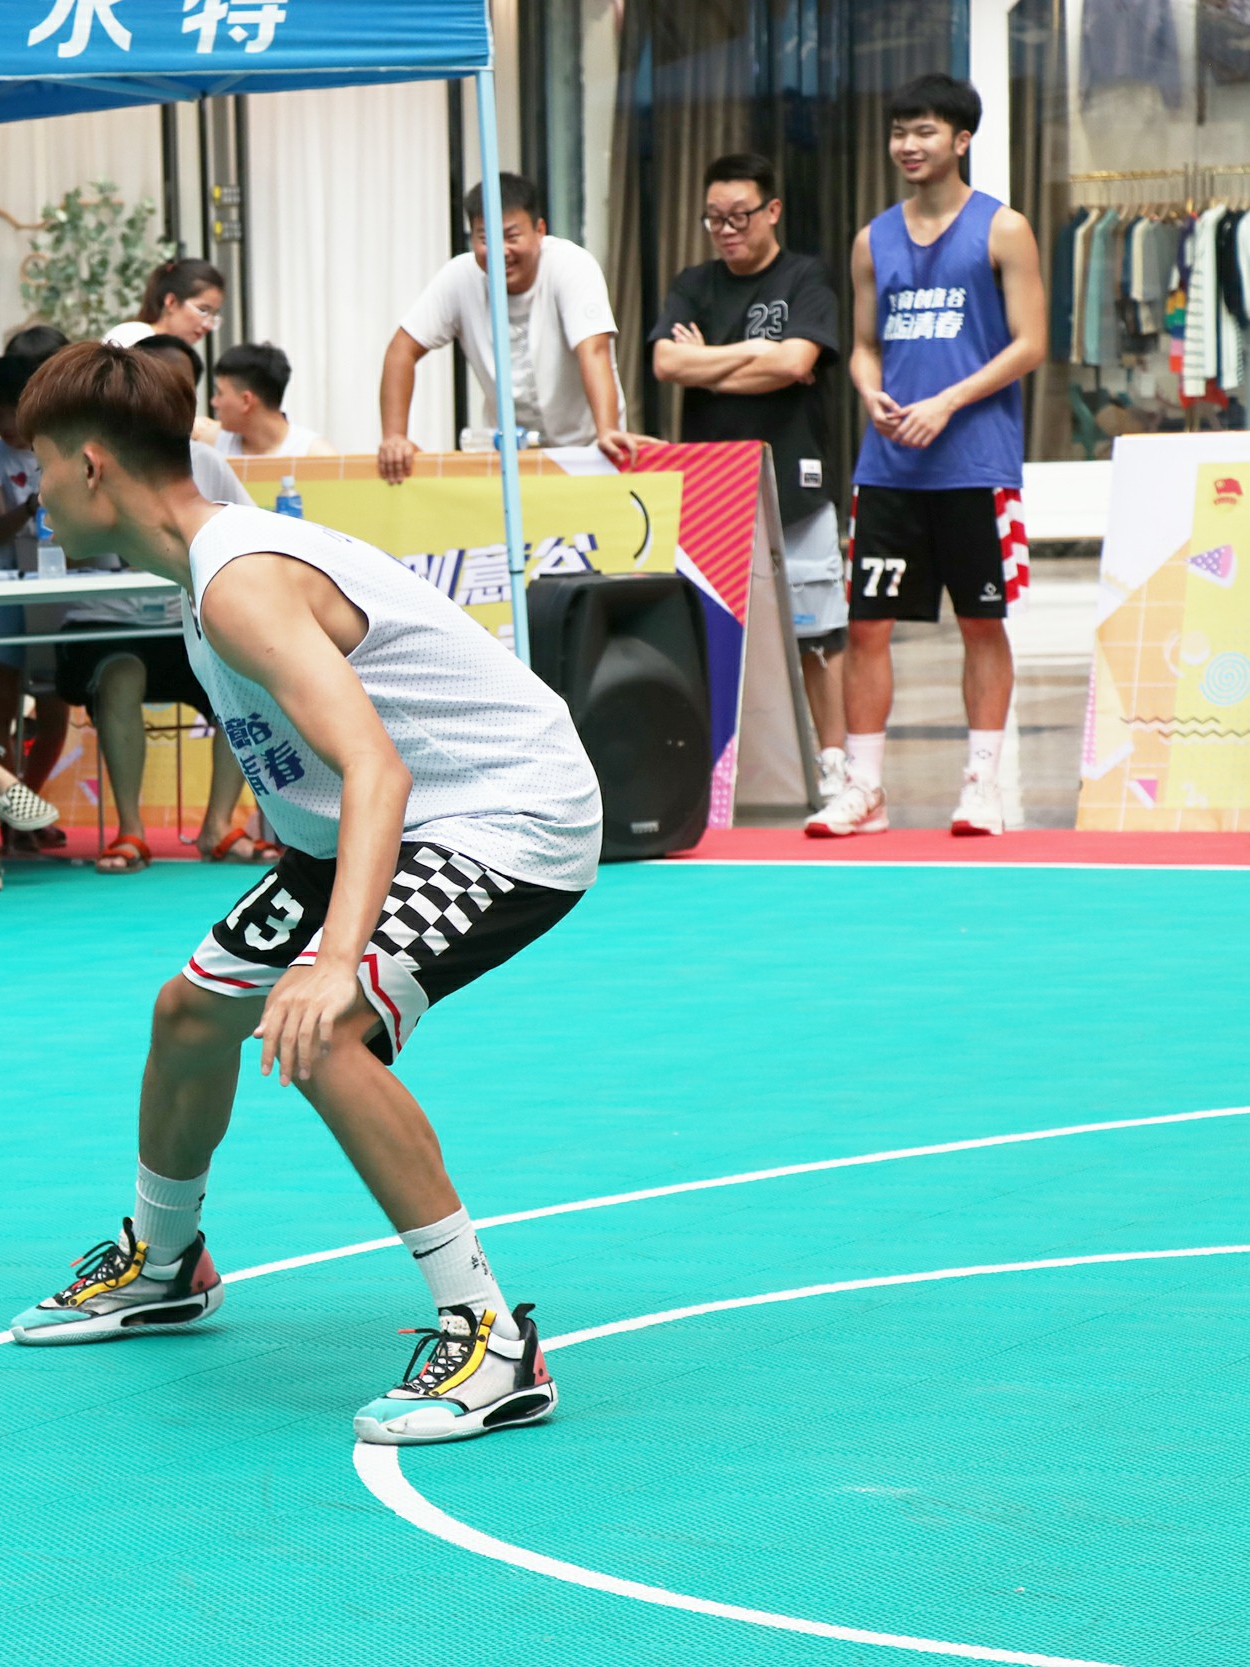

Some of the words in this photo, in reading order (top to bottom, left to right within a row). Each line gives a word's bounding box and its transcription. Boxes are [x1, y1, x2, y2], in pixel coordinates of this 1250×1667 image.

[746, 301, 789, 342] 23
[861, 557, 907, 598] 77
[225, 872, 305, 951] 13
